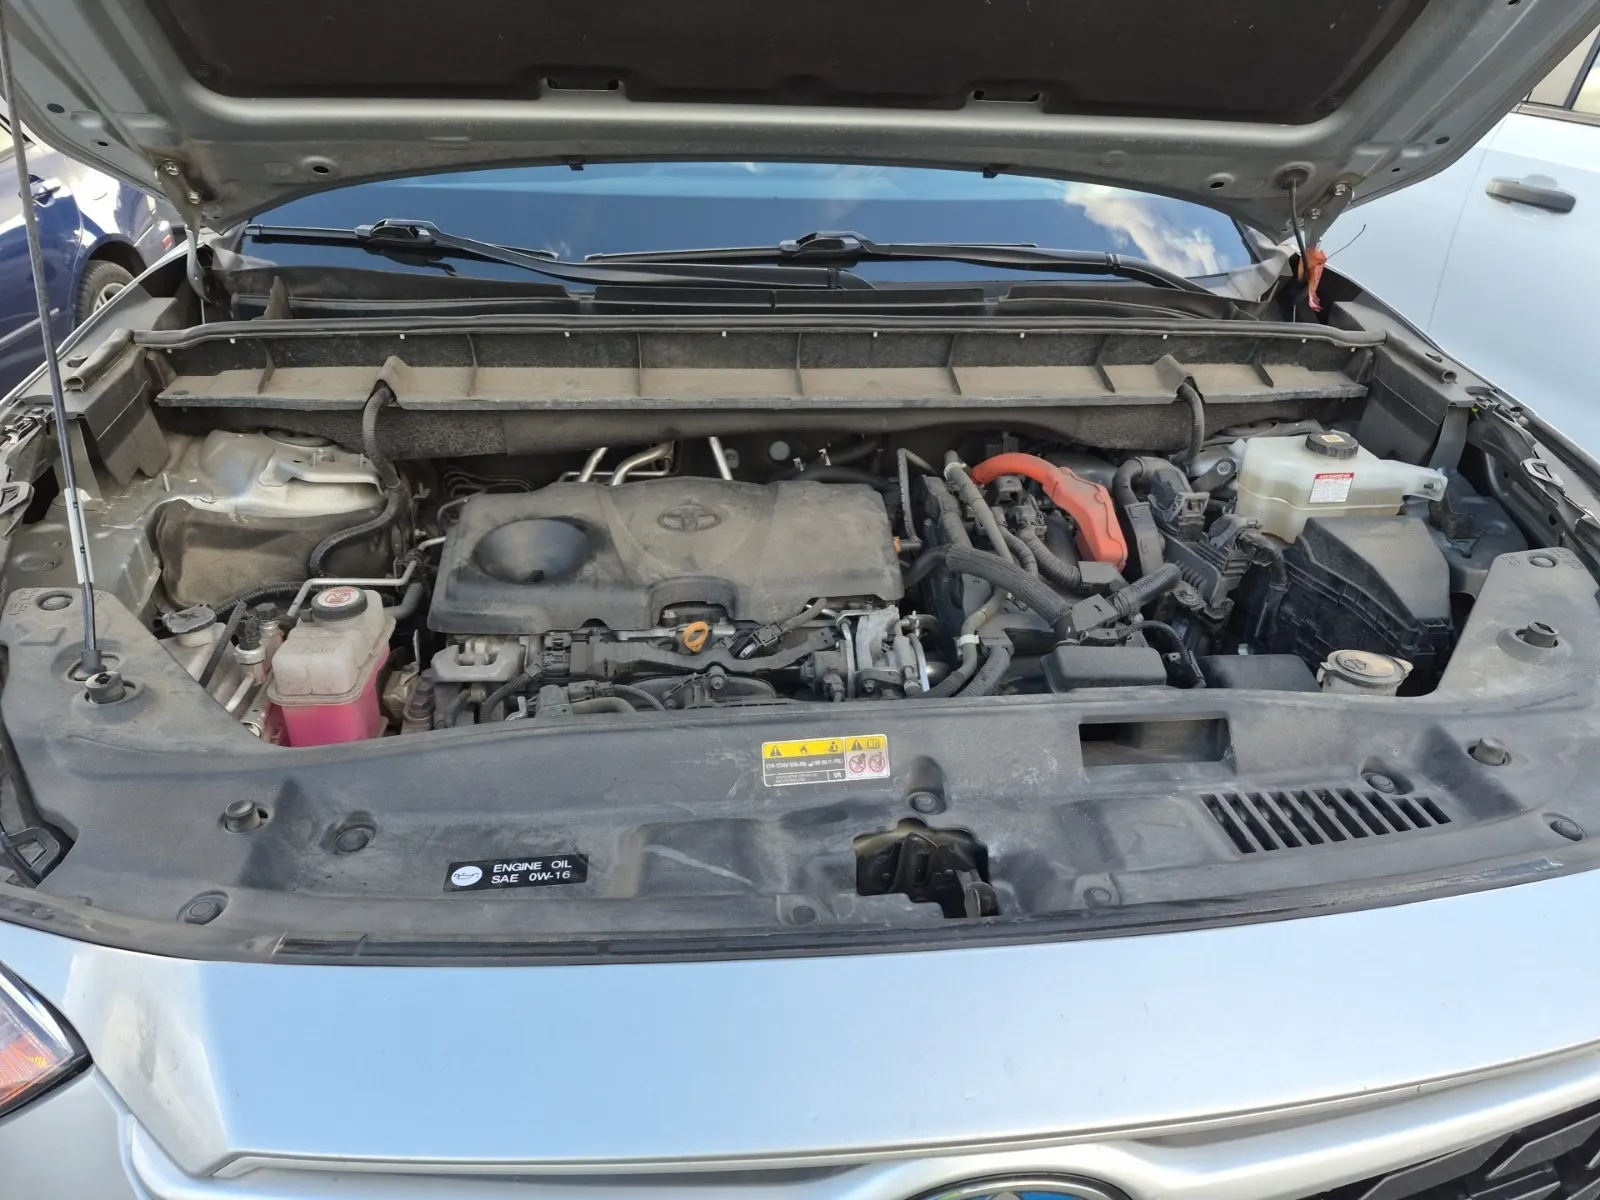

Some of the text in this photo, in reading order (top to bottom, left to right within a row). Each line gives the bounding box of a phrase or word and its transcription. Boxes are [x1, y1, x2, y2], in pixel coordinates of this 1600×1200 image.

[493, 860, 572, 872] ENGINE OIL
[491, 870, 571, 884] SAE 0W-16
